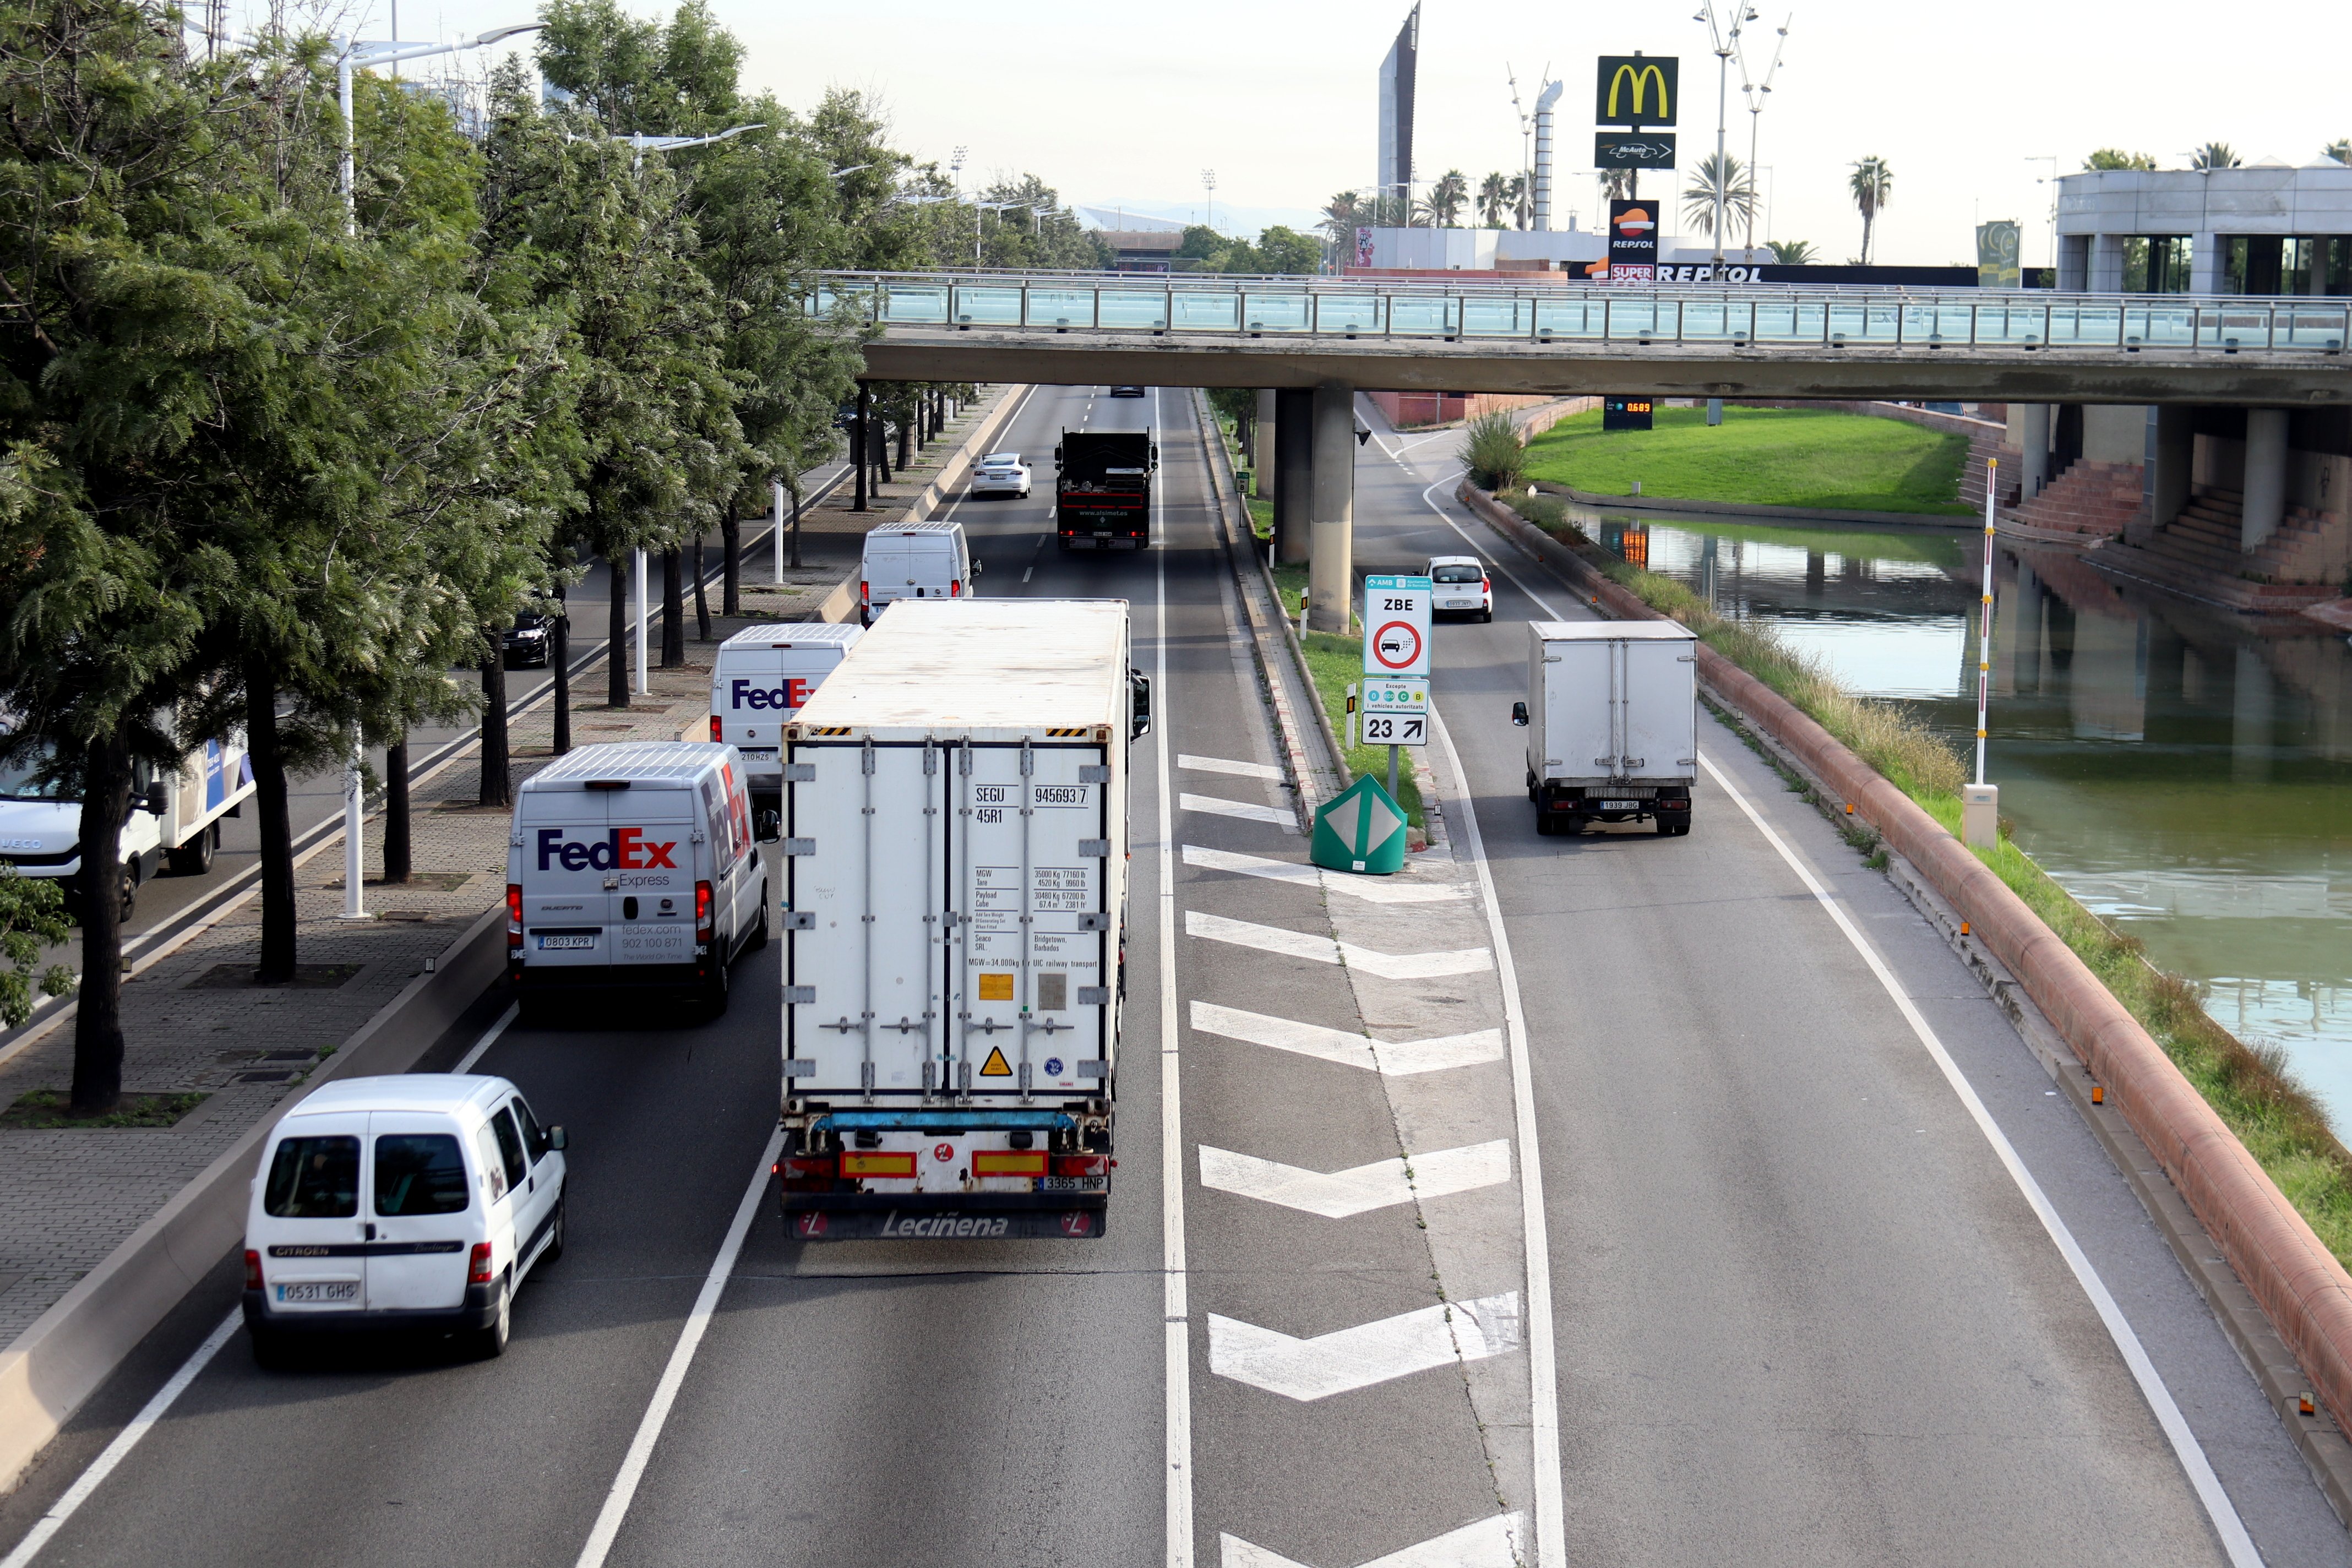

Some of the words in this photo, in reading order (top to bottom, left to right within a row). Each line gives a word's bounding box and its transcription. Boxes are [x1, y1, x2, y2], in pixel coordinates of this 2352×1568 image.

[1613, 266, 1651, 277] SUPER
[1627, 403, 1650, 412] 0.689
[1384, 598, 1413, 611] ZBE
[732, 678, 816, 710] FedE
[1369, 720, 1392, 737] 23
[976, 788, 1004, 802] SEGU
[1035, 788, 1076, 803] 945693
[1080, 789, 1087, 803] 7
[977, 809, 1002, 823] 45R1
[2, 839, 42, 848] VECO
[538, 827, 677, 871] FedEx
[1053, 870, 1060, 879] Kg
[619, 874, 669, 888] Express
[1053, 879, 1060, 888] Kg
[976, 891, 997, 900] Payload
[1053, 892, 1060, 901] Kg
[622, 924, 681, 934] fedex.com
[546, 937, 570, 946] 0803
[573, 937, 589, 946] KPR
[623, 939, 641, 948] 902
[645, 939, 662, 948] 100
[665, 938, 682, 947] 871
[1035, 935, 1067, 944] Bridgetown,
[968, 959, 1019, 968] MGW=34,000kg
[1046, 960, 1068, 968] railway
[1048, 1178, 1075, 1189] 3365
[1082, 1178, 1103, 1189] HNP
[881, 1210, 1009, 1237] Leciñena
[276, 1246, 329, 1256] CITROËN
[287, 1284, 320, 1299] 0531
[327, 1284, 357, 1298] GHS
